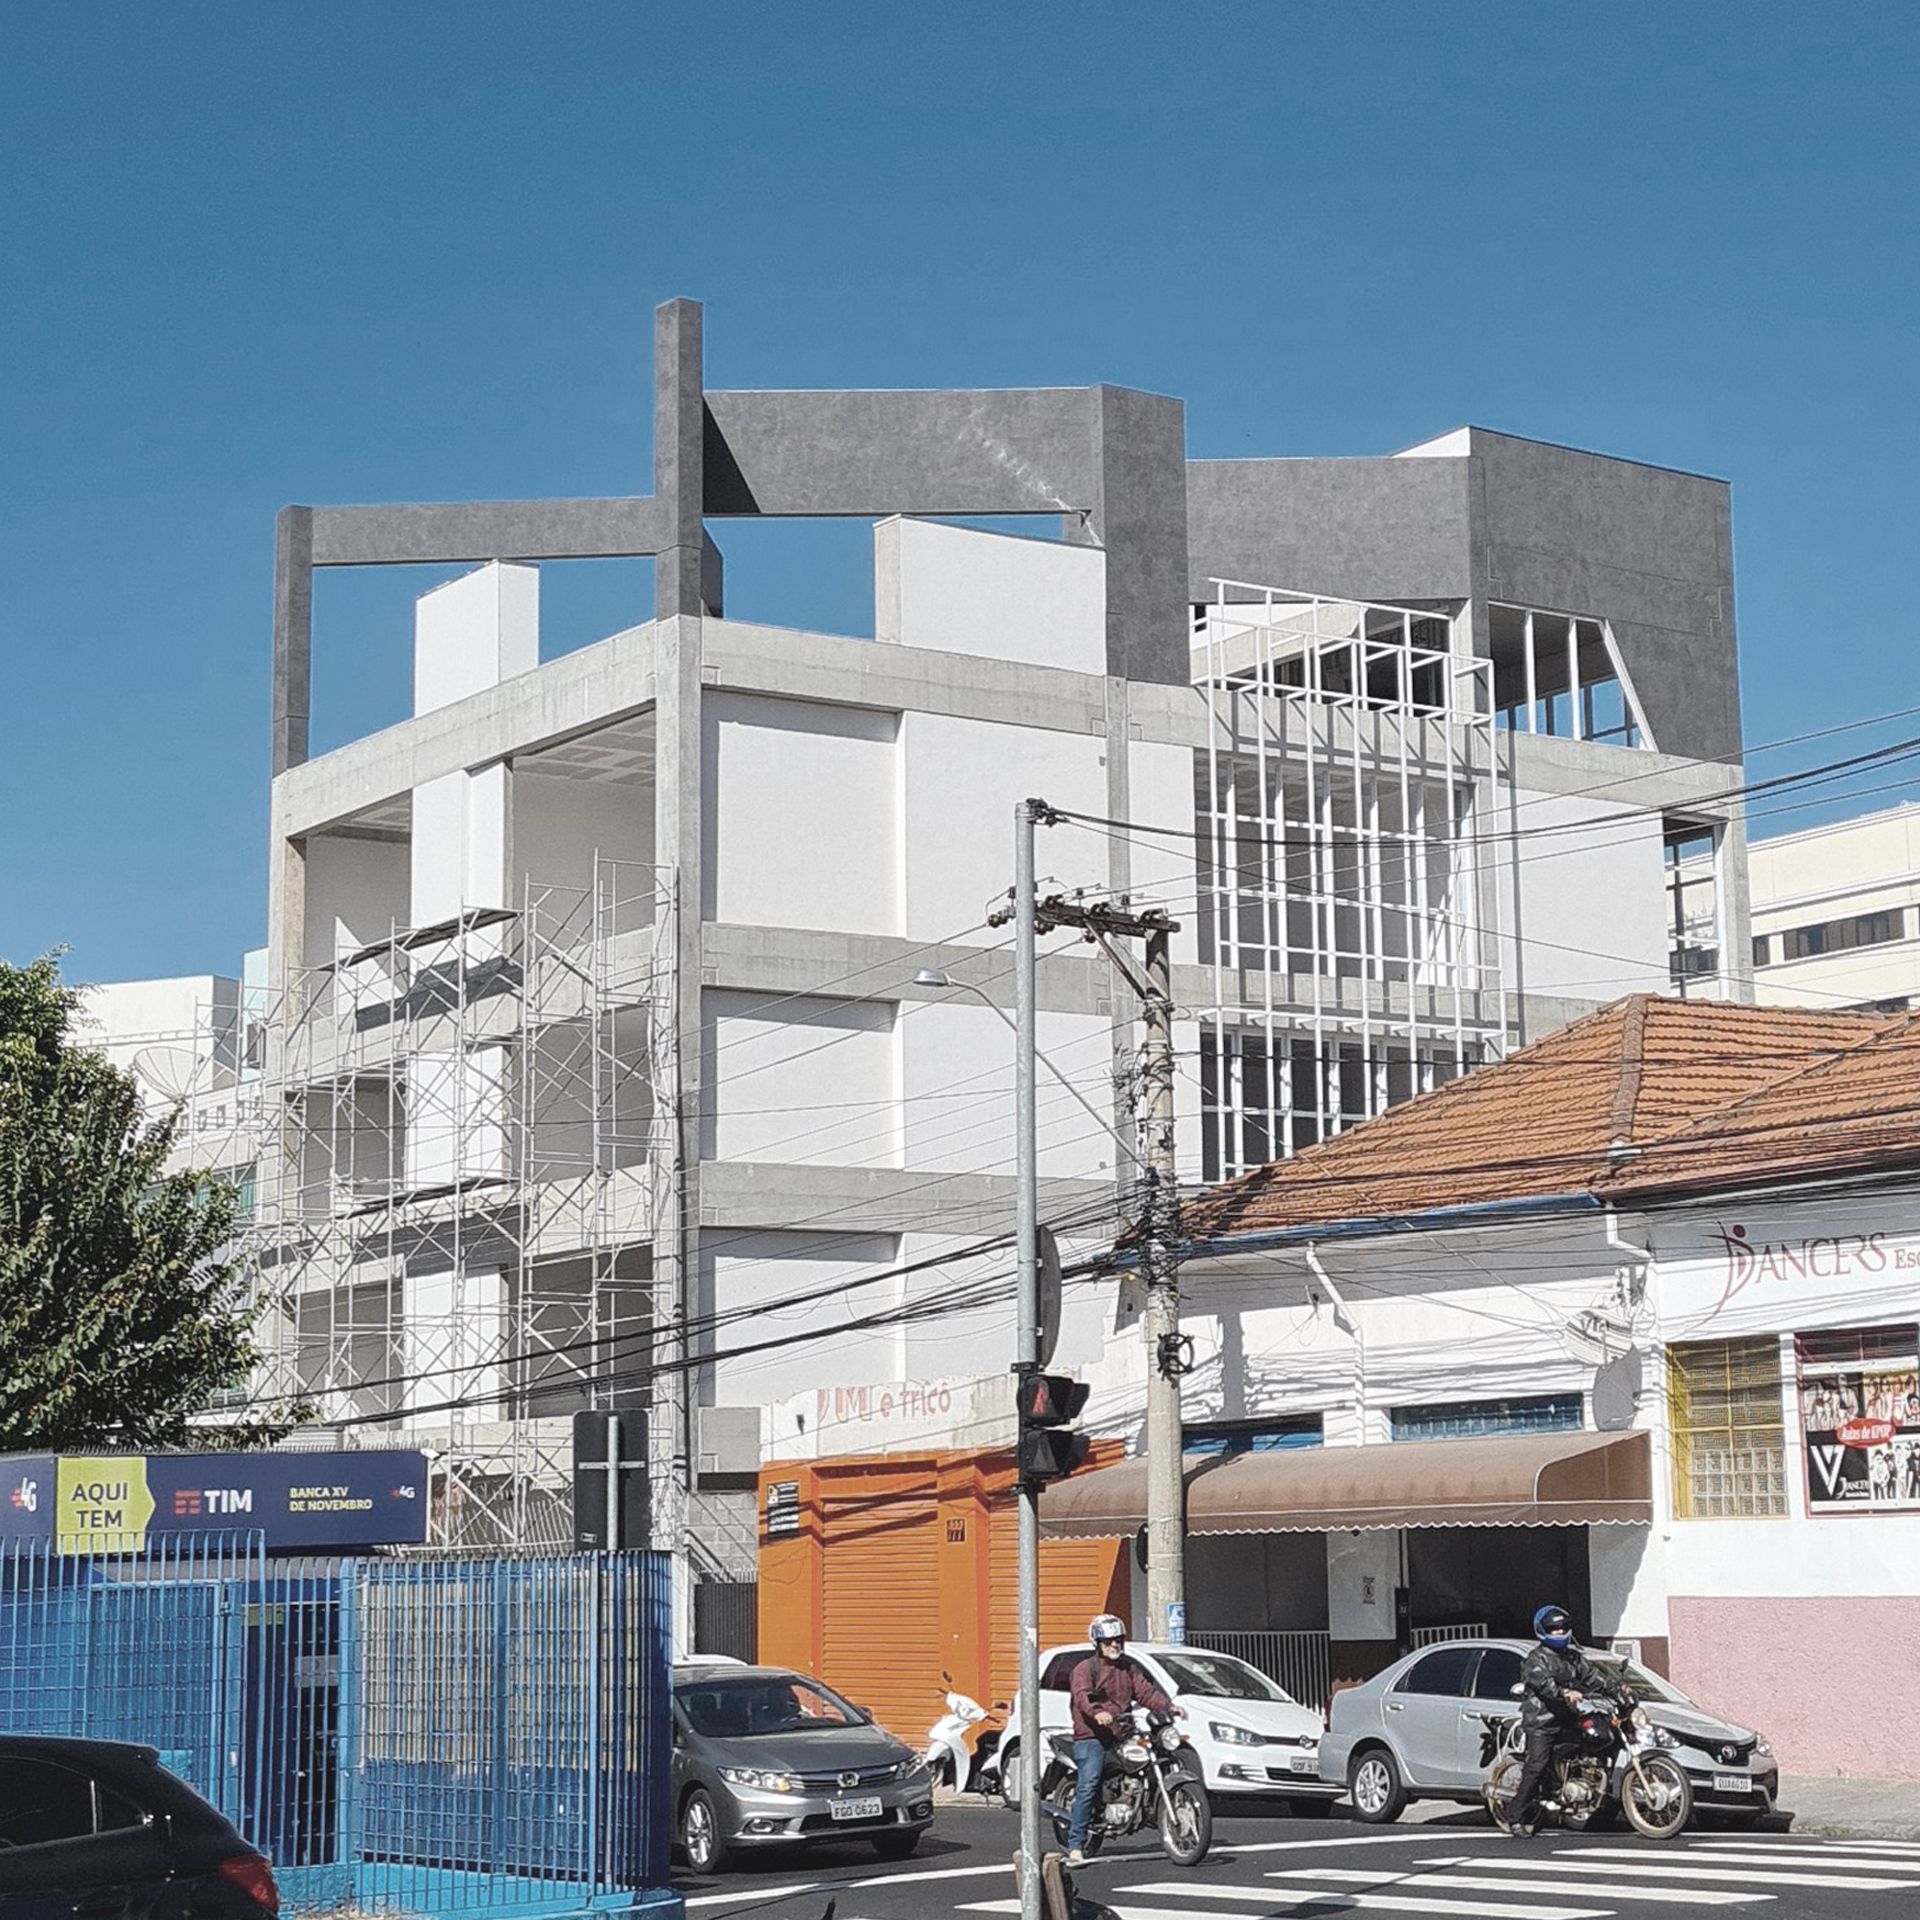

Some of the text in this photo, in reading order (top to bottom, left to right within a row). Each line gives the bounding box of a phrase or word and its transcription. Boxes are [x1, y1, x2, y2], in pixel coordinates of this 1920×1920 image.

[71, 1482, 128, 1505] AQUI
[204, 1489, 252, 1513] TIM
[290, 1487, 349, 1498] BANCA XV
[290, 1499, 373, 1511] DE NOVEMBRO
[76, 1510, 122, 1528] TEM
